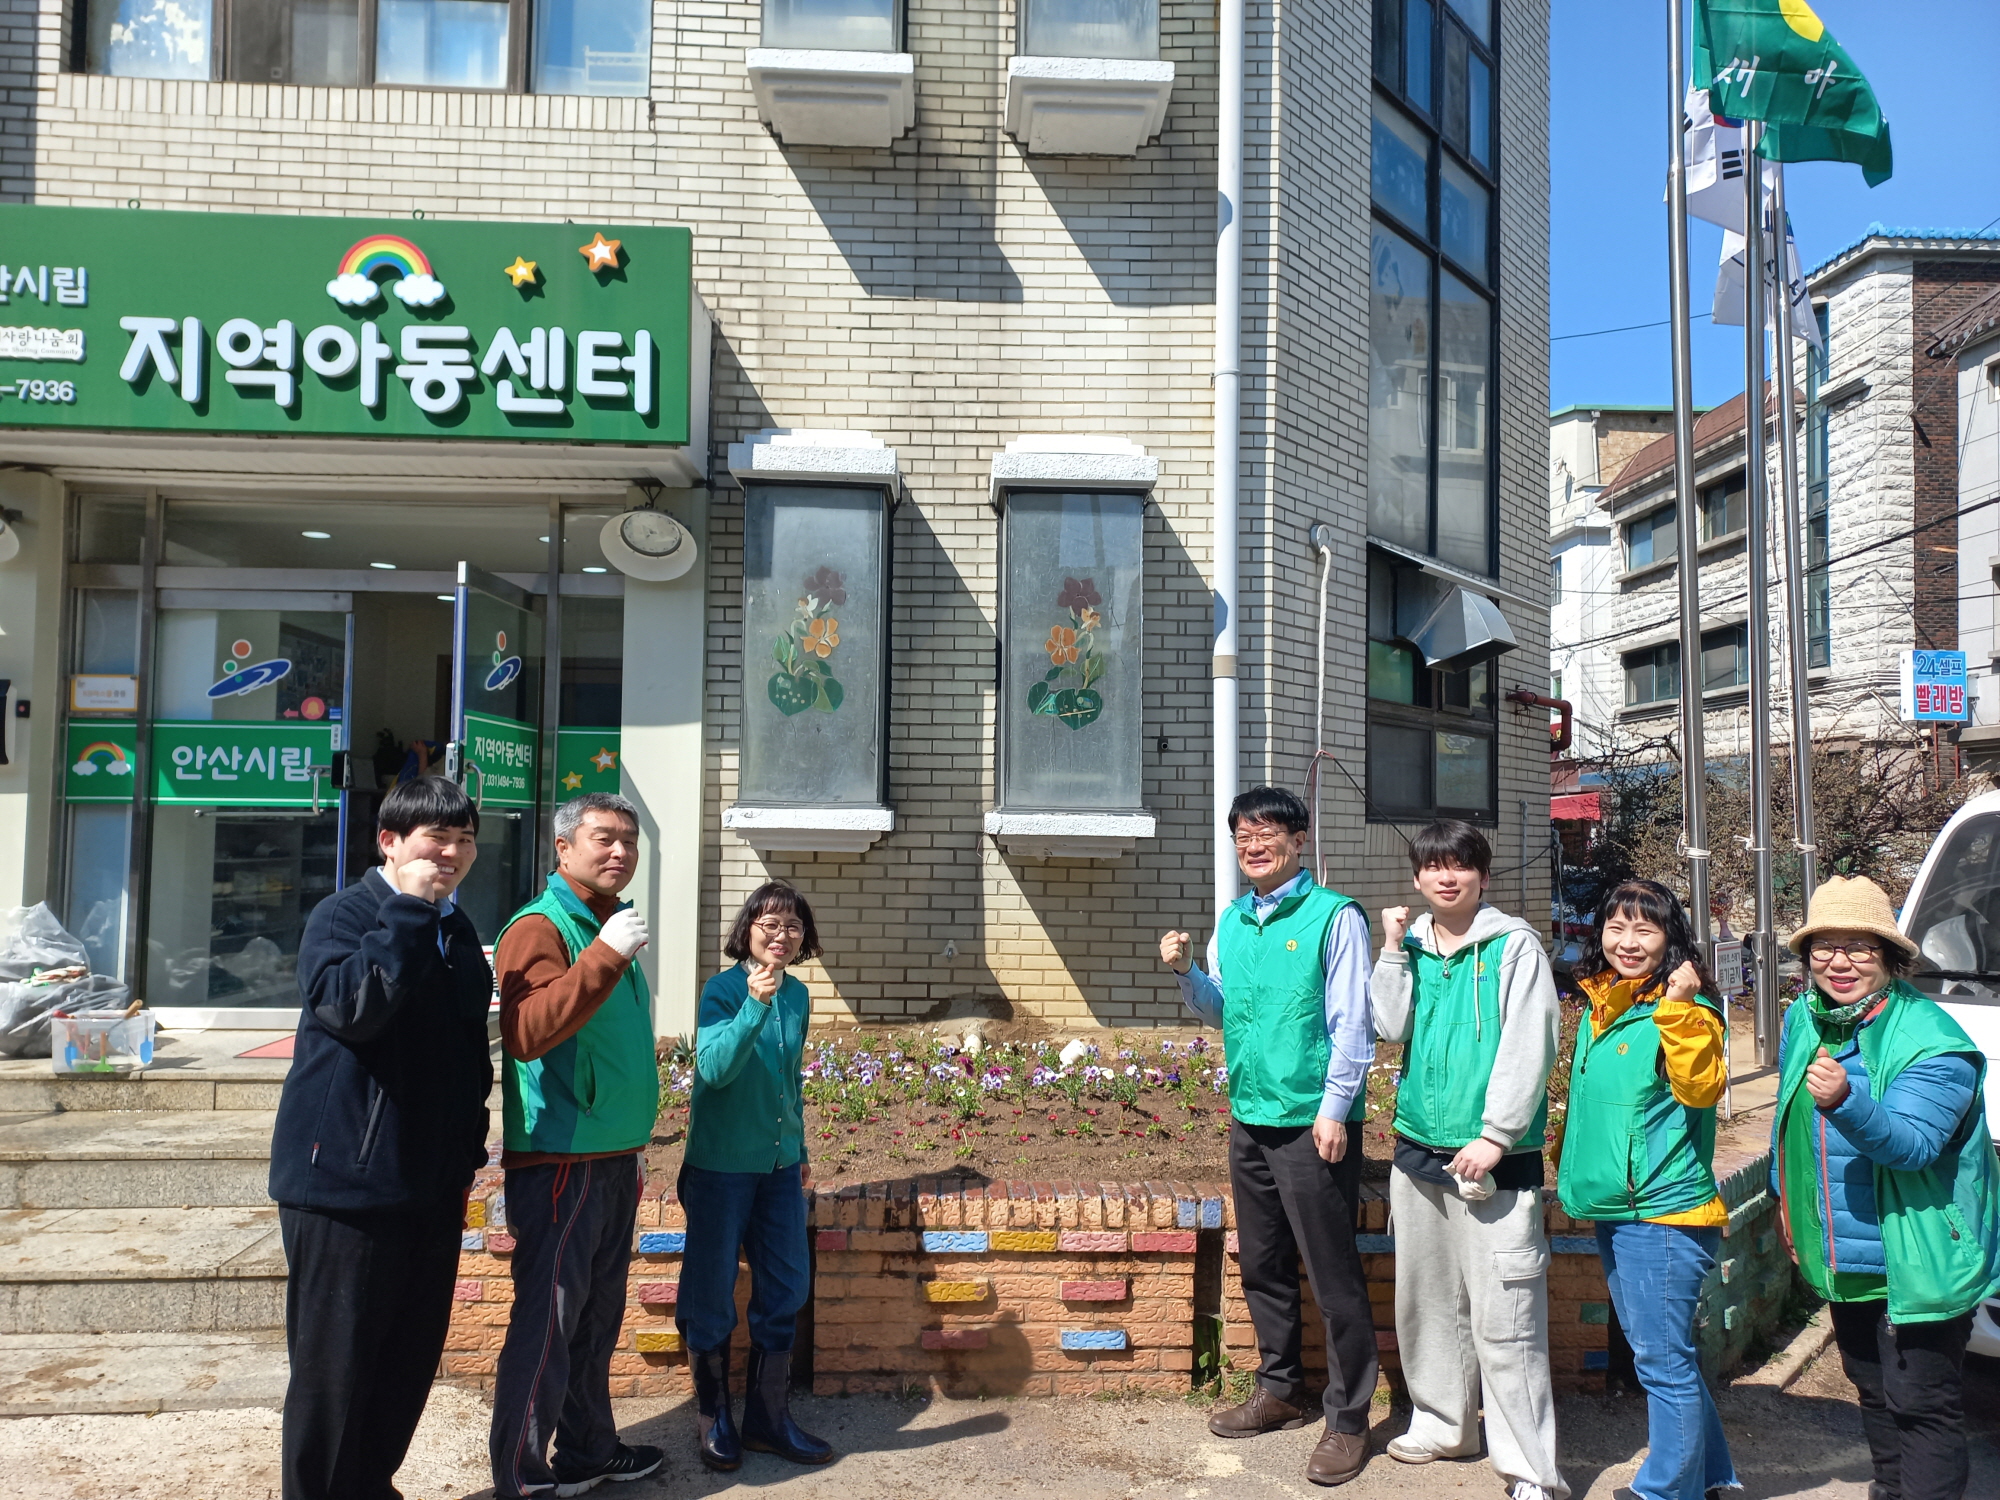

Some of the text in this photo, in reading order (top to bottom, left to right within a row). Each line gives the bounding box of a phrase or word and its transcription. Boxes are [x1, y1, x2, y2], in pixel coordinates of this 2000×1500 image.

[118, 315, 653, 416] 지역아동센터
[1916, 684, 1964, 714] 빨래방
[171, 744, 312, 782] 안산시립
[474, 736, 532, 768] 지역아동센터
[1719, 966, 1741, 986] 투기금지
